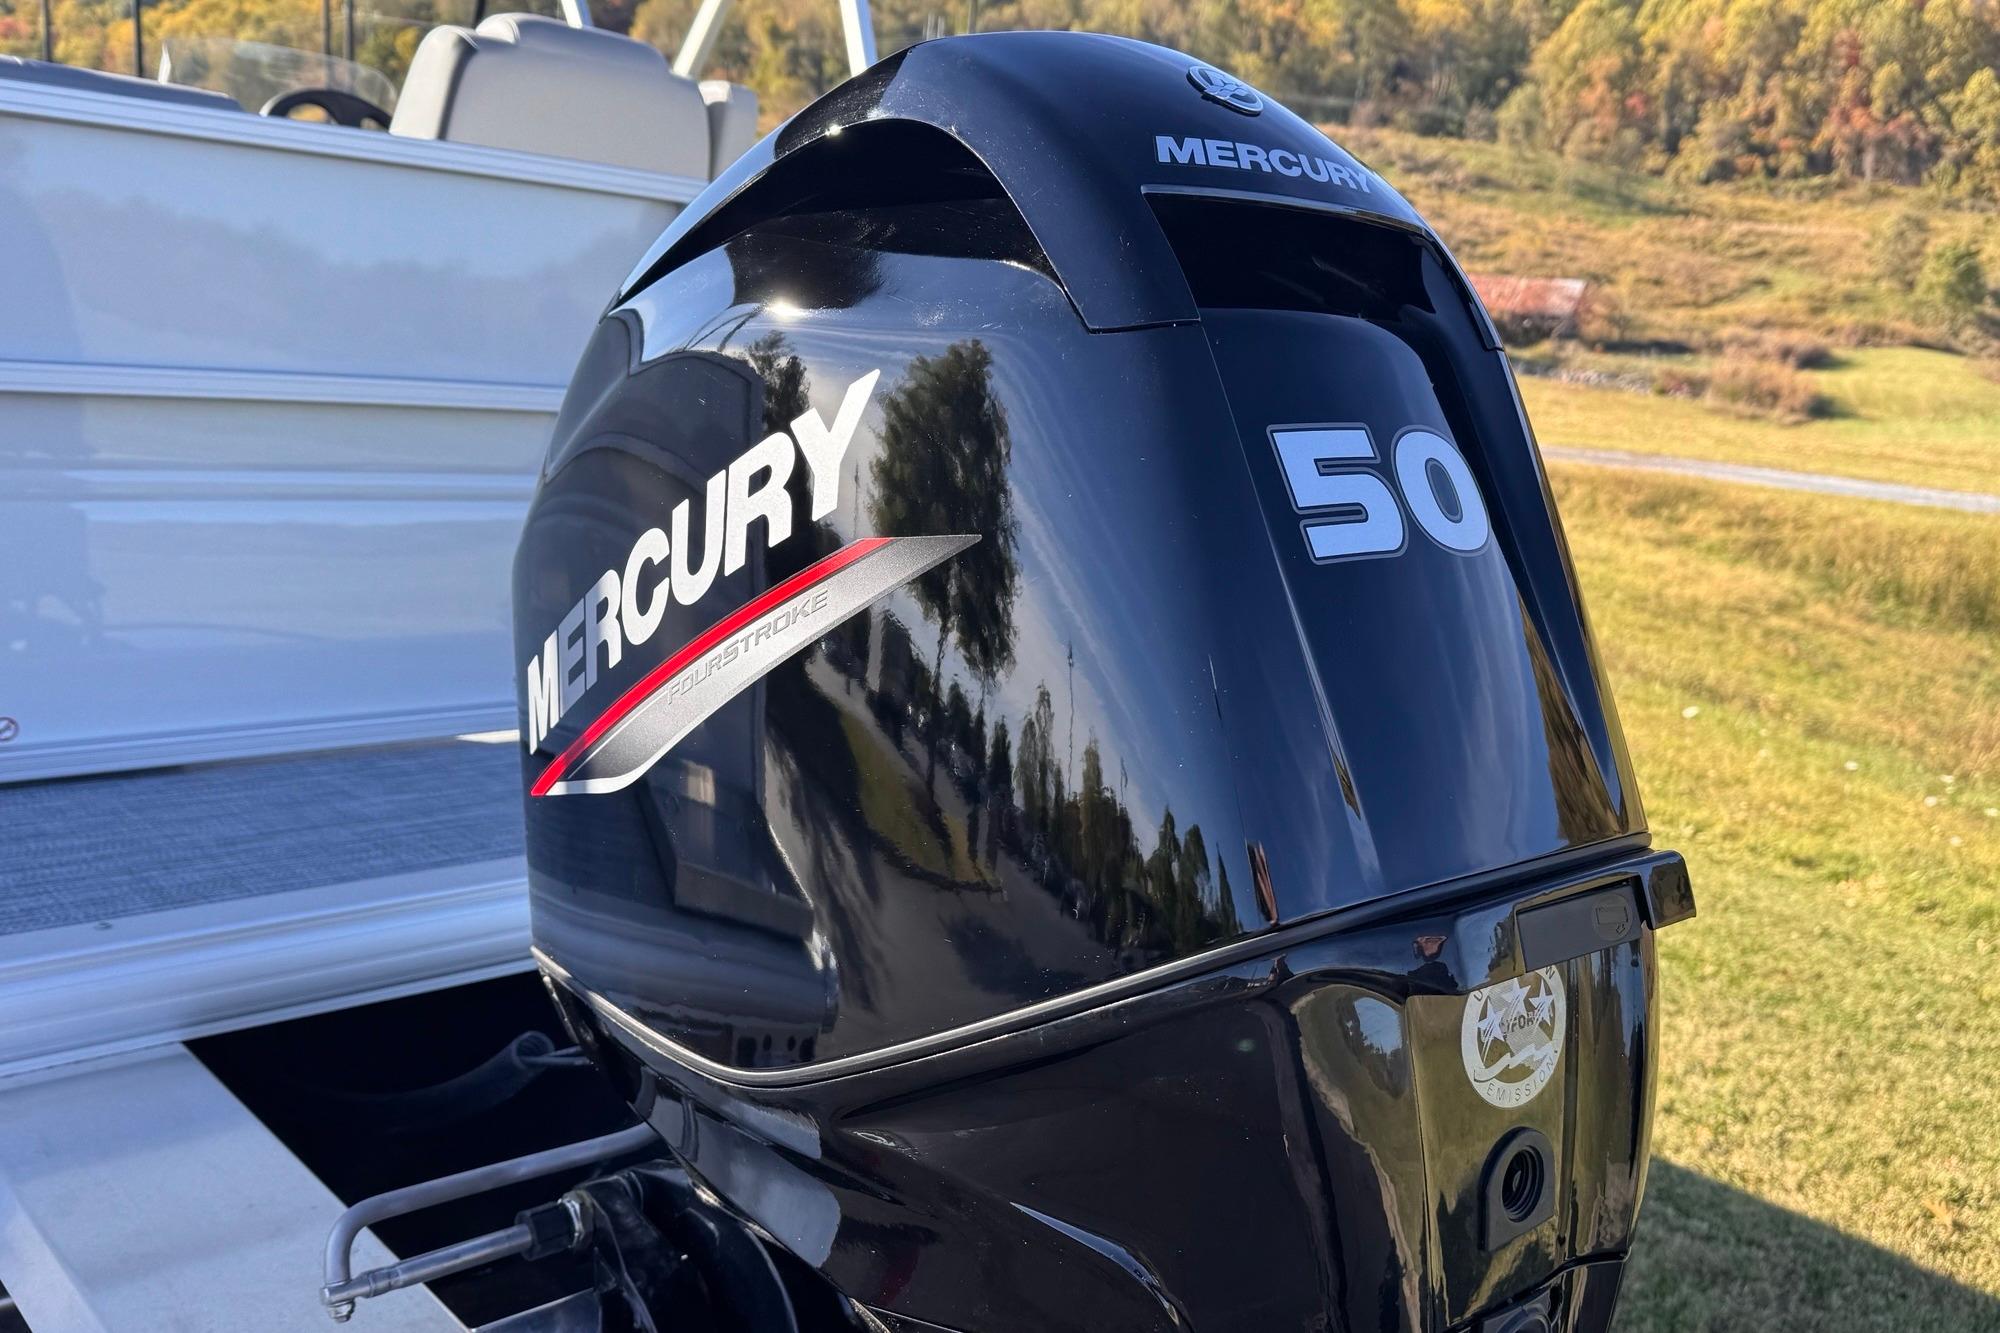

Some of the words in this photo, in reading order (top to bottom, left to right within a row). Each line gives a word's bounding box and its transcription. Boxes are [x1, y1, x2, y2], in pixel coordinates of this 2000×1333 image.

[1155, 135, 1371, 194] MERCURY
[1268, 423, 1490, 564] 50
[527, 368, 881, 756] MERCURY
[665, 587, 829, 706] FOURSTROKE
[1485, 1055, 1555, 1103] EMISSION
